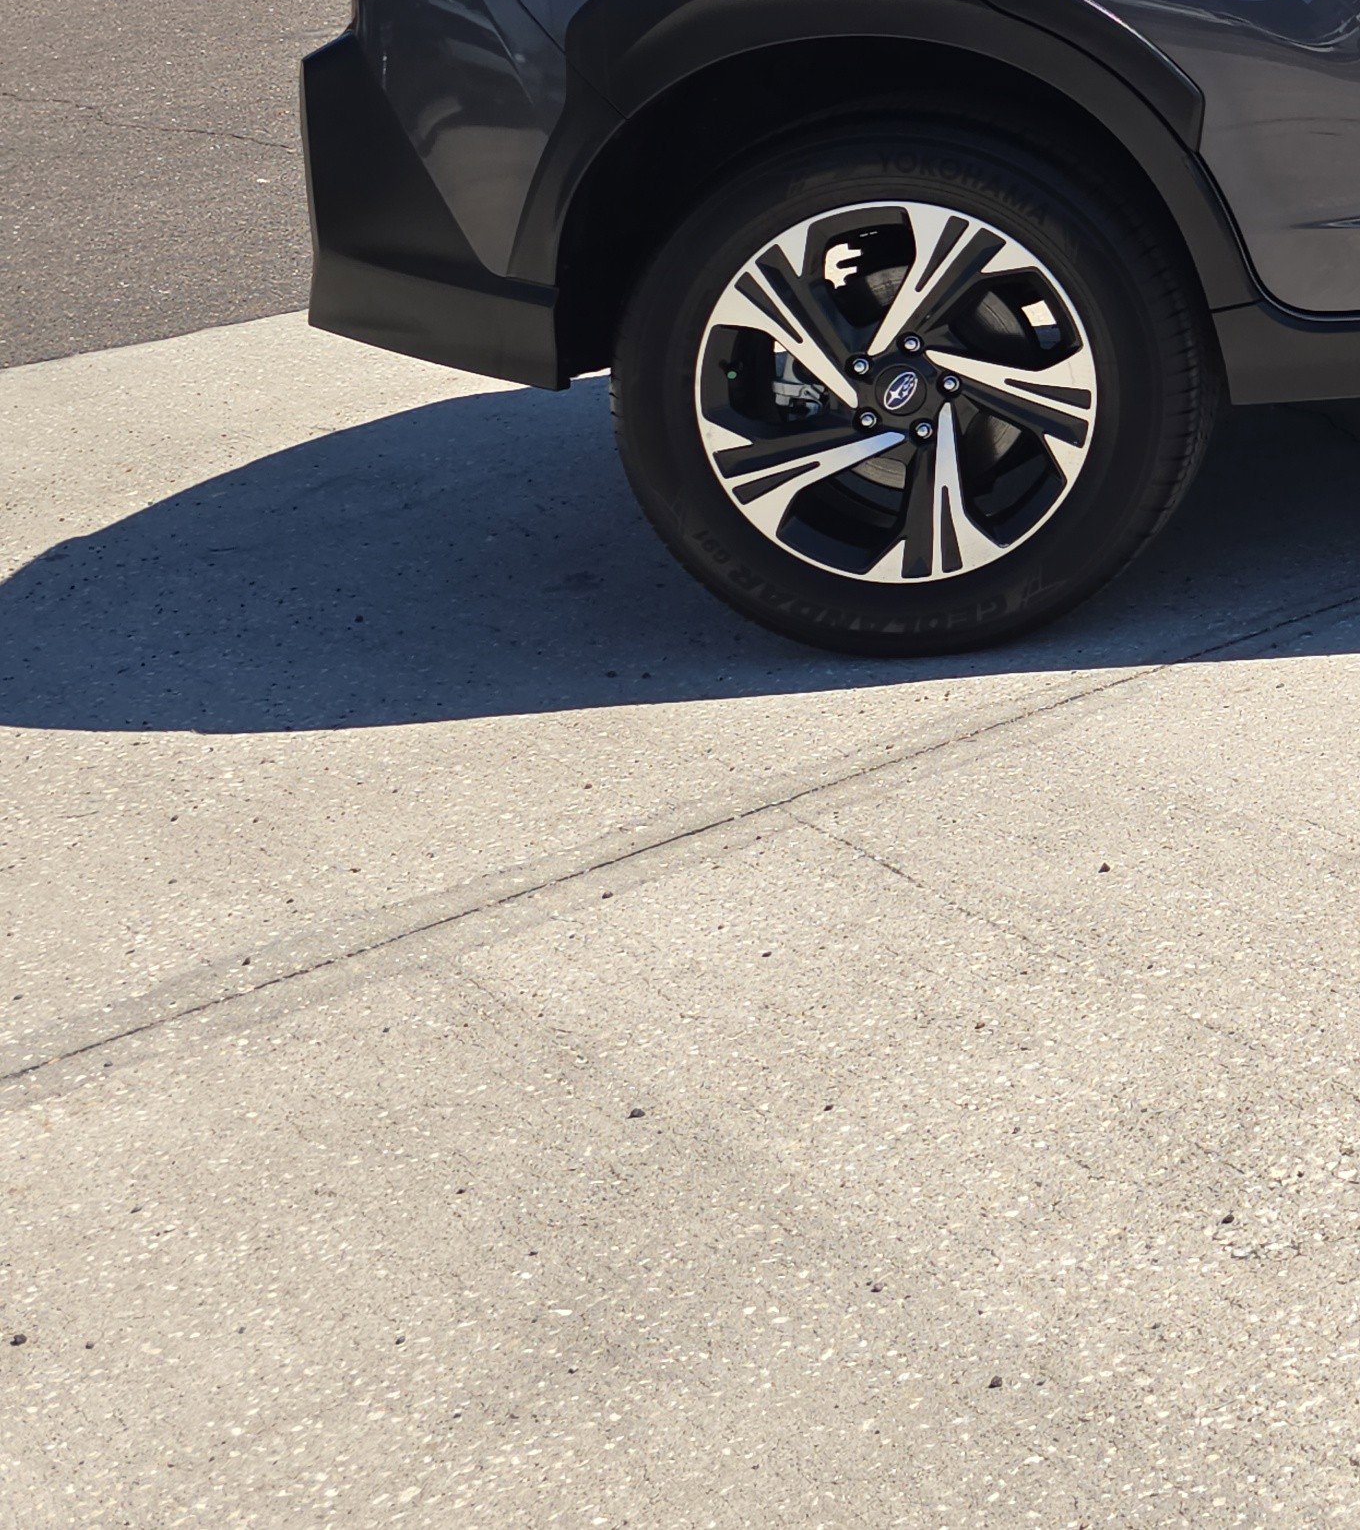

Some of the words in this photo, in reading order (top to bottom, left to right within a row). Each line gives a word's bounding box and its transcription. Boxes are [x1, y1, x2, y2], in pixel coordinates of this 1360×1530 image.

[879, 151, 1048, 225] YOKOHAMA
[692, 527, 732, 565] G91
[728, 562, 1011, 636] GEOLANDAR
